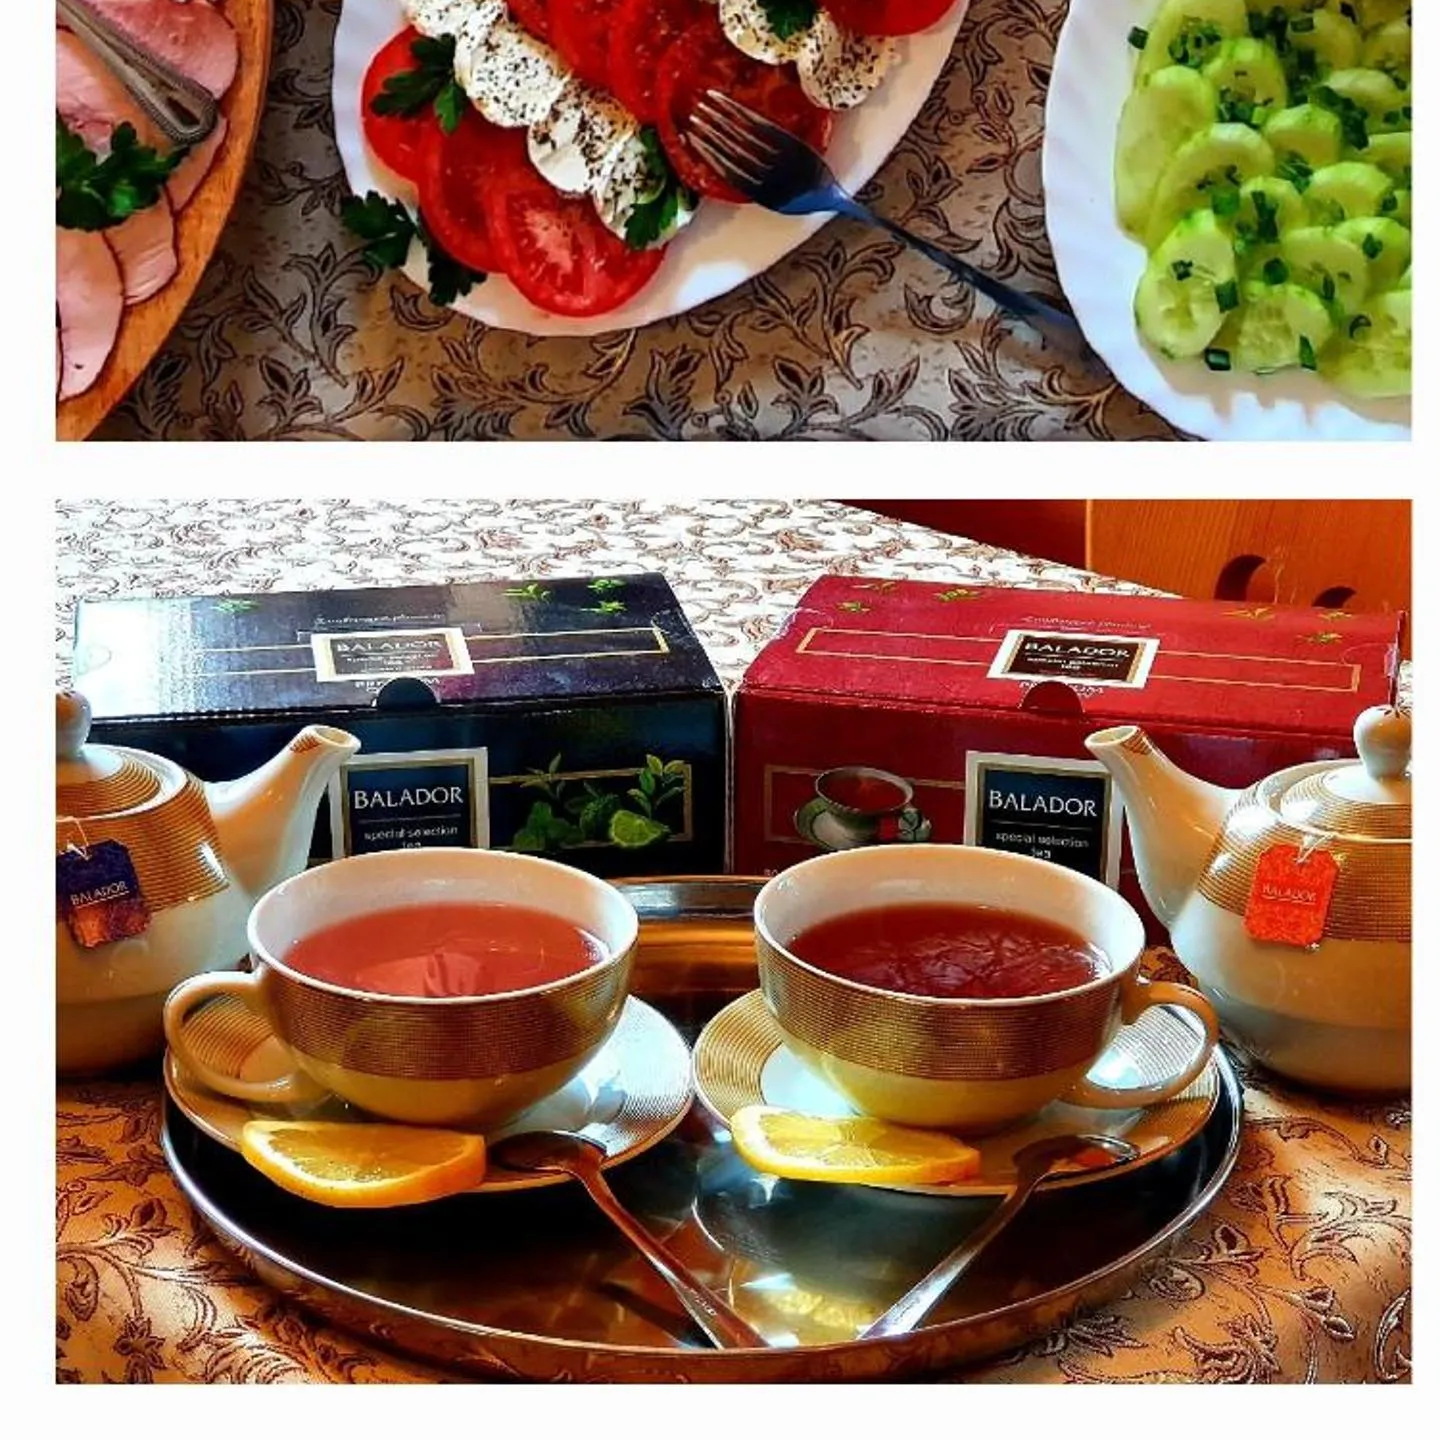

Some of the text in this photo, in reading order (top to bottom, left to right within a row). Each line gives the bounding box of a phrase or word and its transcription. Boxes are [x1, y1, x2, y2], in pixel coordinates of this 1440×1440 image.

[1024, 641, 1131, 658] BALADOR
[353, 786, 464, 810] BALADOR
[988, 789, 1098, 818] BALADOR
